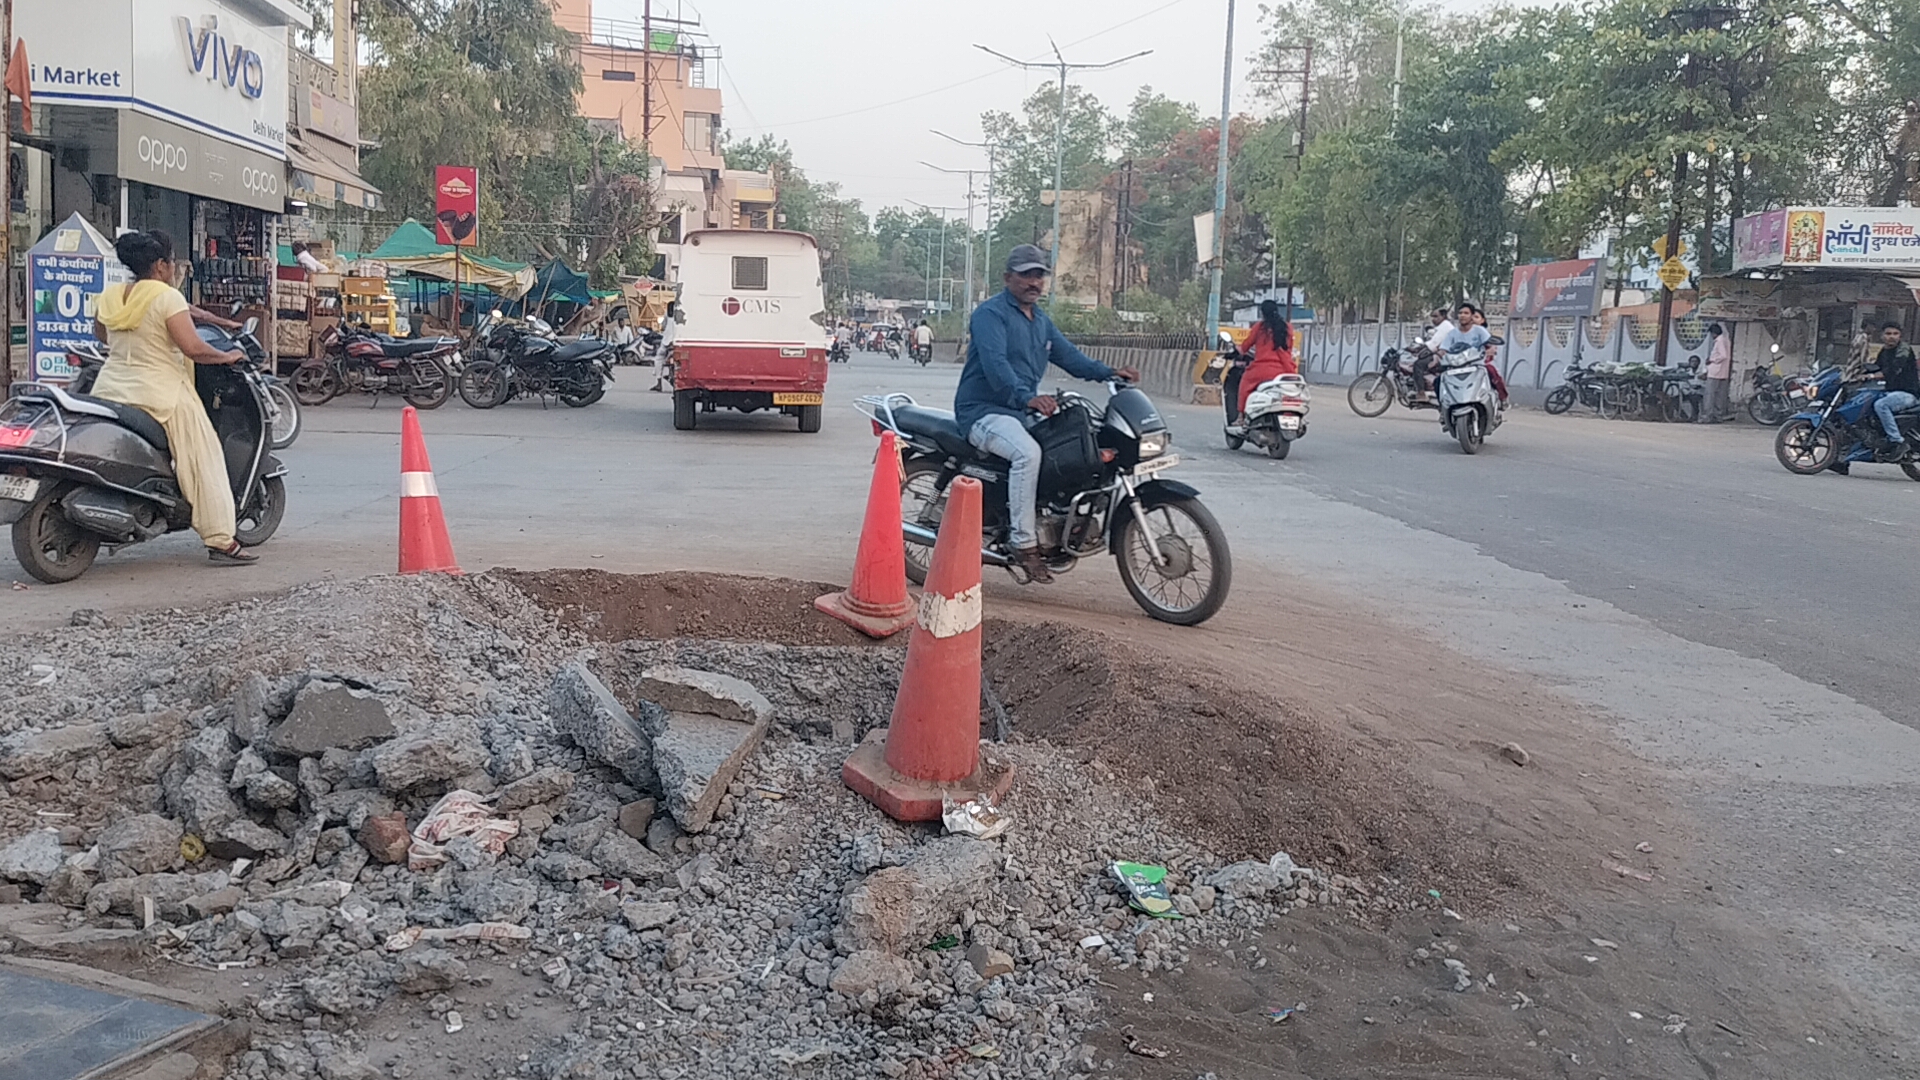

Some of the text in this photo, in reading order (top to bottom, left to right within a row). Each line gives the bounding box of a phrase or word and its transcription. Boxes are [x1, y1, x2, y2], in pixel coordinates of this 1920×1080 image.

[177, 15, 263, 99] vivo
[44, 66, 120, 88] Market
[138, 135, 187, 174] oppo
[243, 166, 277, 197] oppo
[1872, 222, 1914, 236] नामदेव
[1871, 233, 1920, 251] दुग्ध एजे
[742, 299, 781, 314] CMS
[36, 321, 70, 334] डाउन
